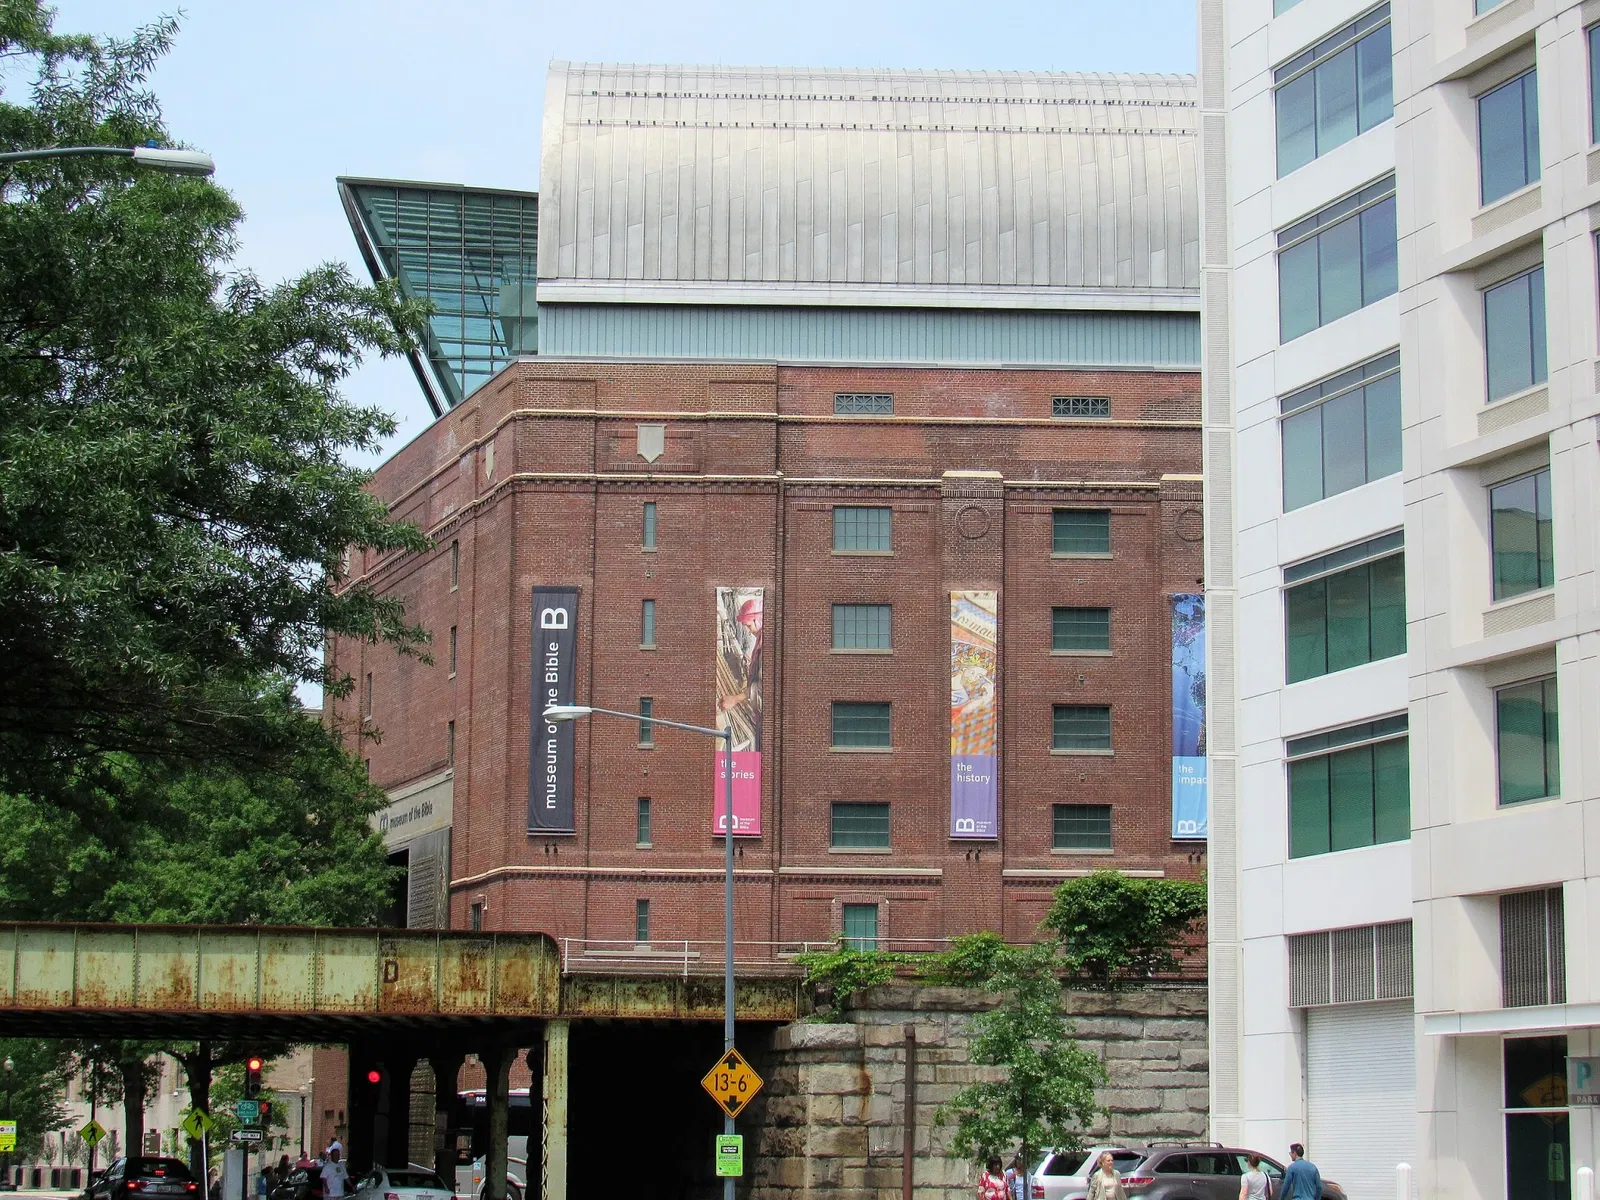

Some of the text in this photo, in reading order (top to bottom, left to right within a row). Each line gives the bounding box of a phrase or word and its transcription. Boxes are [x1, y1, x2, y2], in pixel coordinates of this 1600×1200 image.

[541, 607, 568, 629] B
[545, 642, 559, 683] Bible
[545, 688, 558, 707] he
[545, 739, 557, 809] museum
[720, 769, 755, 779] sories
[957, 762, 973, 772] the
[1178, 764, 1194, 774] the
[957, 773, 990, 785] history
[390, 812, 408, 829] museum
[408, 807, 414, 823] of
[413, 805, 421, 821] the
[421, 799, 433, 818] Bible
[956, 818, 974, 832] B
[1575, 1062, 1591, 1089] P
